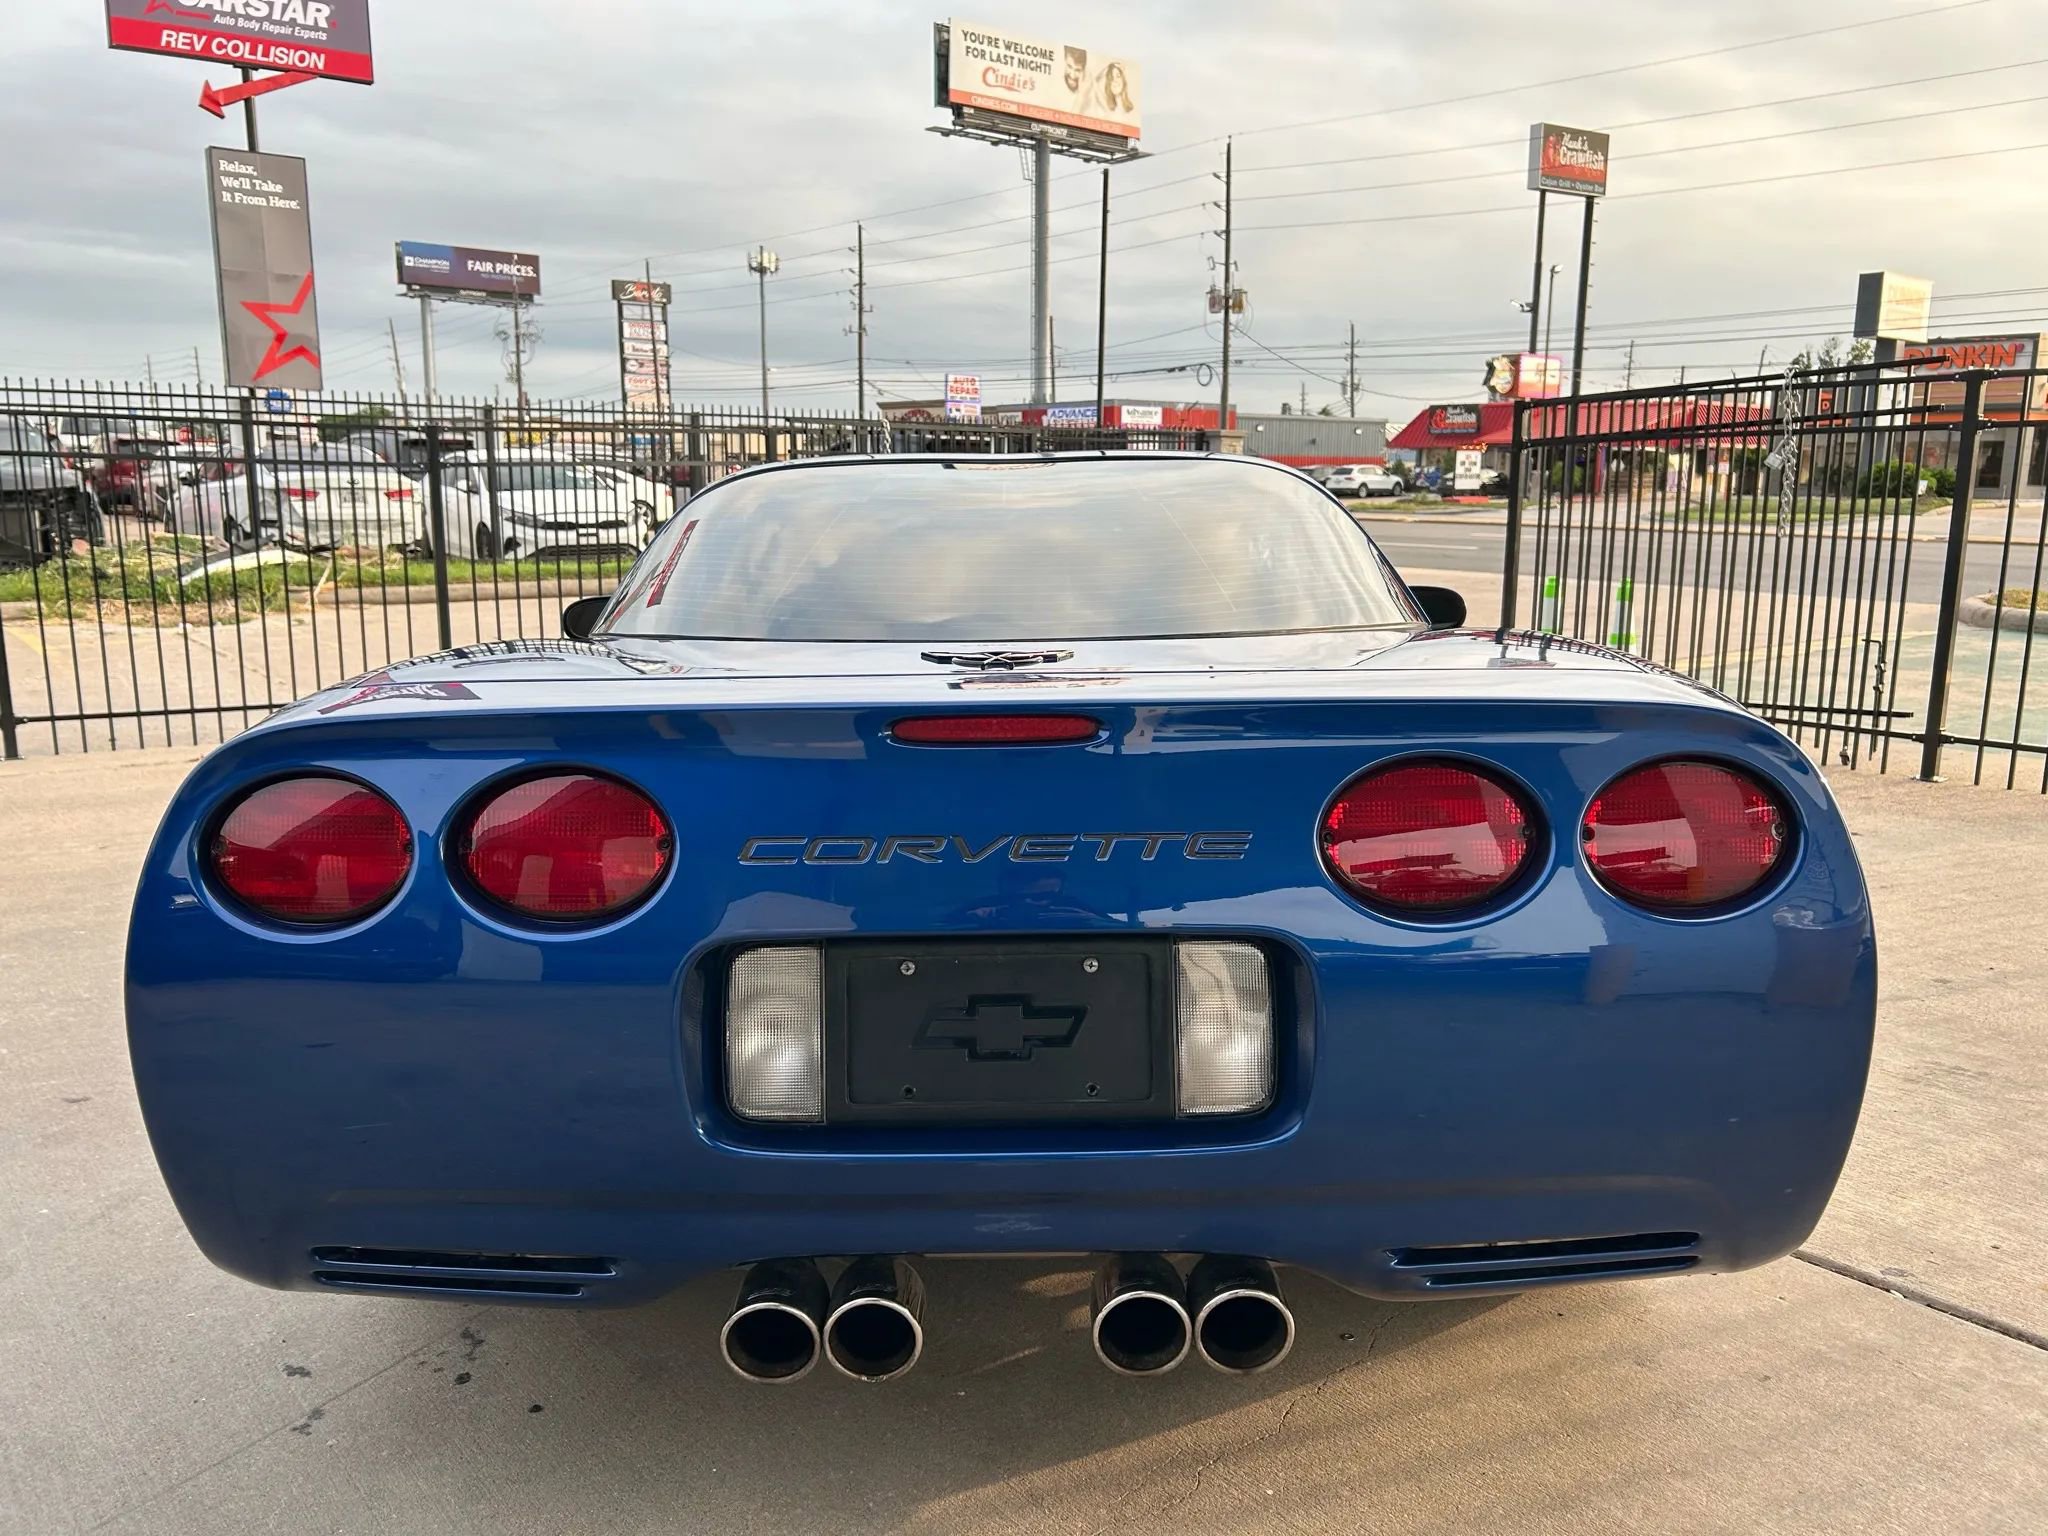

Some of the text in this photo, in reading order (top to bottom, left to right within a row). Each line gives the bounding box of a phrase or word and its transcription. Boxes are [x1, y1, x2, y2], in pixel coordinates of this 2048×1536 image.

[213, 14, 327, 41] Auto Body Repair Experts
[160, 29, 326, 70] REV COLLISION
[961, 29, 1055, 62] YOU'RE WELCOME
[965, 45, 1052, 75] FOR LAST NIGHT!
[982, 66, 1036, 92] Cindie's
[219, 159, 258, 176] Relax,
[1560, 146, 1604, 171] Crawfish
[220, 175, 283, 193] We'll Take
[221, 191, 233, 203] It
[233, 192, 267, 206] From
[467, 259, 494, 273] FAIR
[495, 262, 537, 278] PRICES.
[949, 385, 980, 395] REPAIR
[737, 831, 1253, 865] CORVETTE
